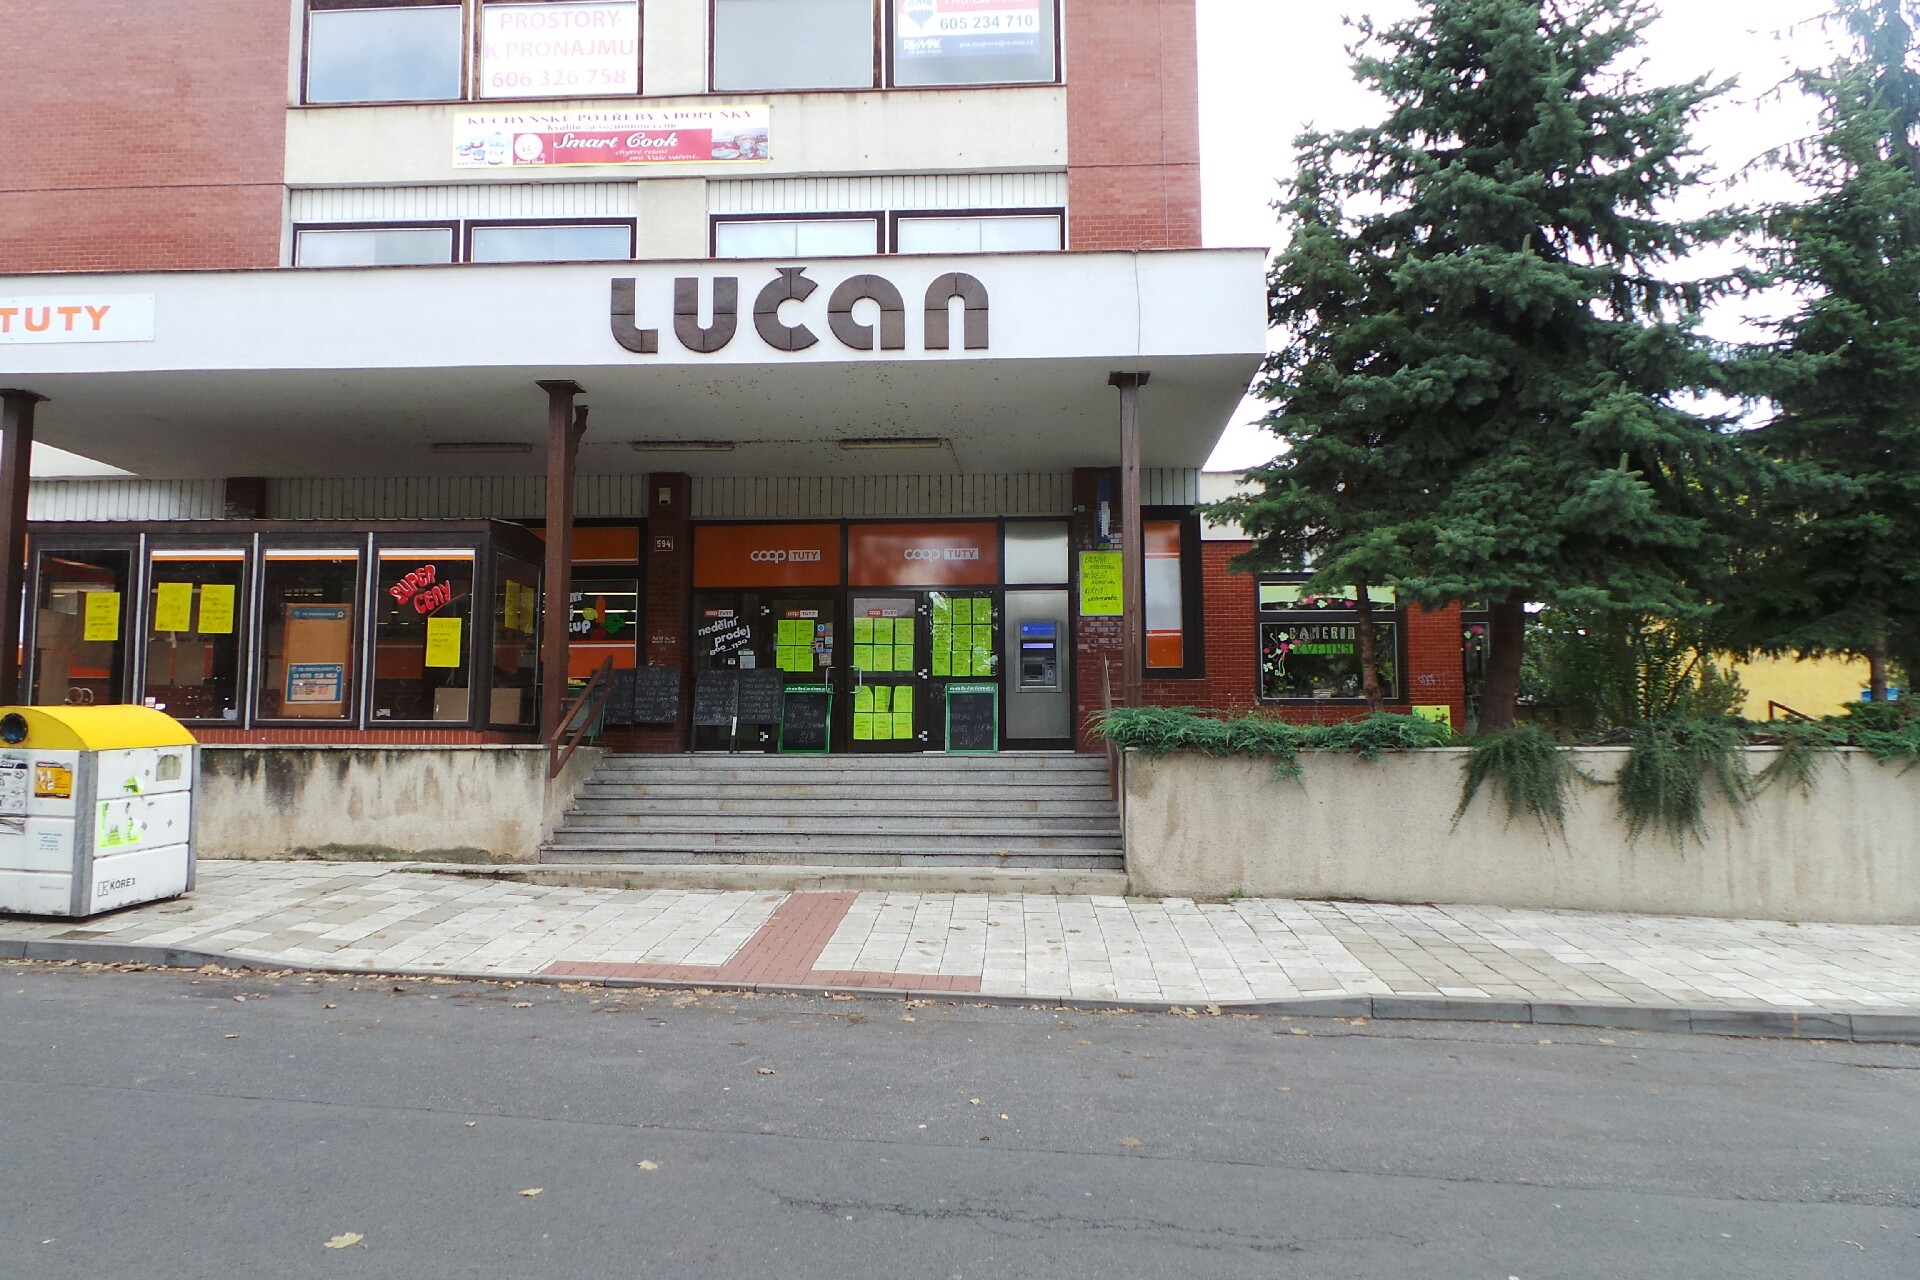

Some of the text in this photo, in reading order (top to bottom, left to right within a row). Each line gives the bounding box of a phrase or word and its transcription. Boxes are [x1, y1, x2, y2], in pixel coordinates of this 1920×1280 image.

[500, 10, 620, 29] PROSTORY
[940, 15, 1033, 30] 605 234 710
[485, 37, 634, 58] K PRONÁJMU
[492, 69, 626, 87] 606 326 758
[552, 131, 678, 149] Smart Cook
[656, 540, 671, 548] 594
[750, 550, 819, 563] coop TUTY
[904, 548, 975, 561] coop TUTY
[389, 565, 436, 604] SUPER
[414, 580, 451, 614] CENY
[698, 616, 739, 636] nedělní
[714, 625, 751, 648] prodej
[110, 877, 136, 890] KOREX
